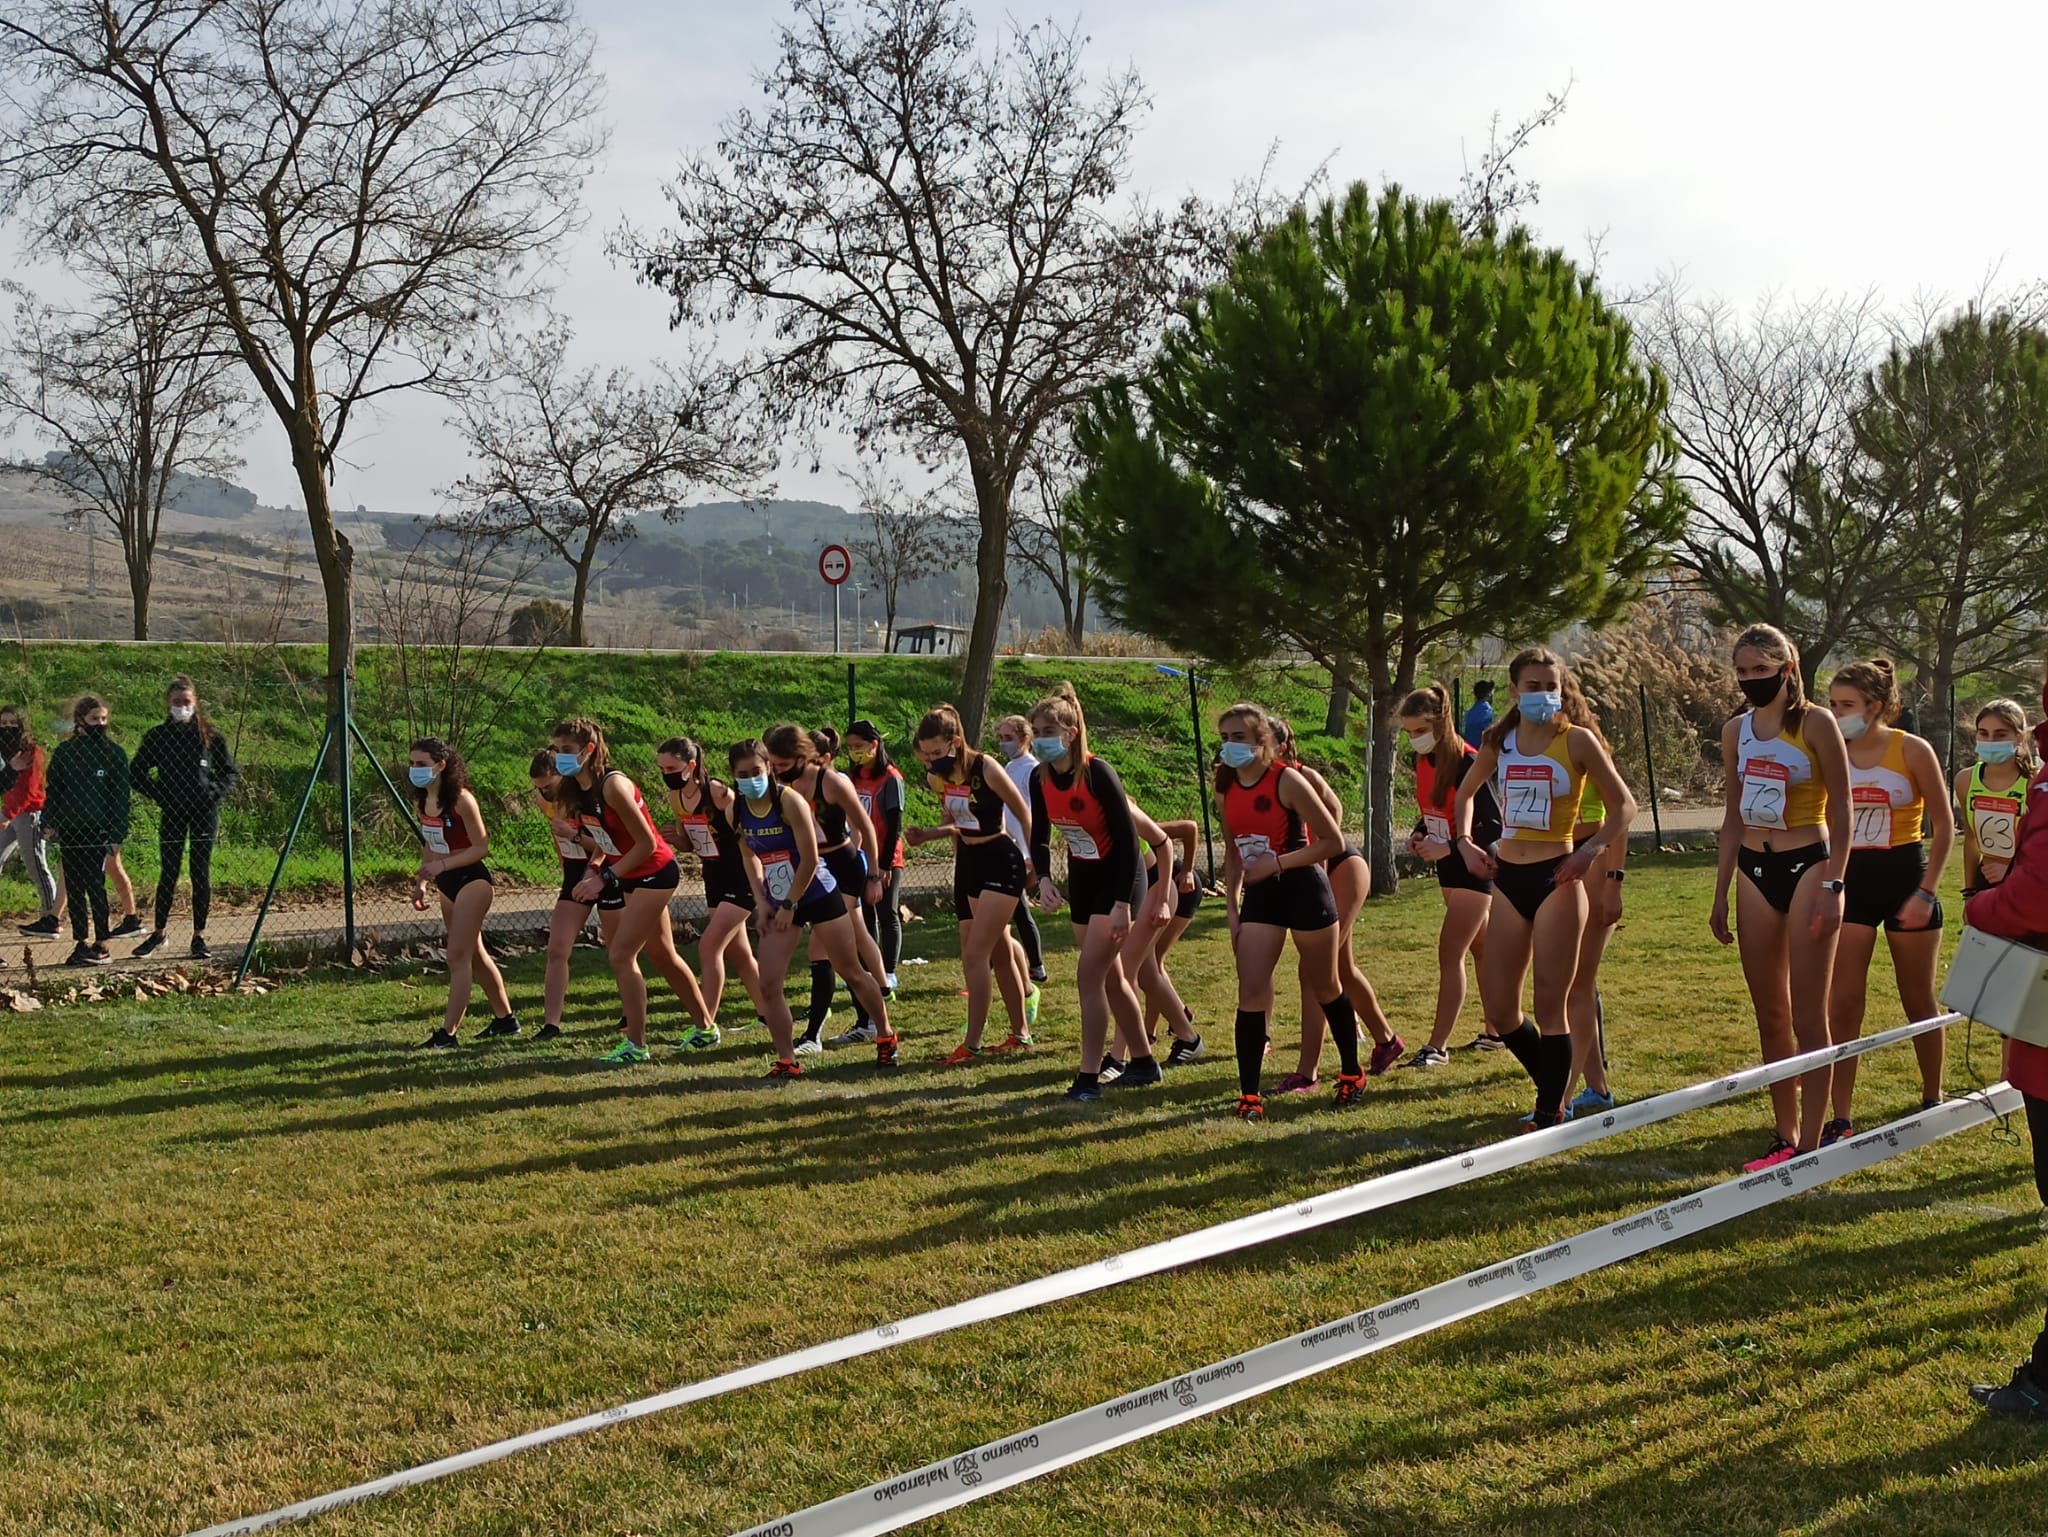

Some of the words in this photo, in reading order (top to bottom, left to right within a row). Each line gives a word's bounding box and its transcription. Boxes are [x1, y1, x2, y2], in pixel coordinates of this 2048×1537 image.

[1508, 786, 1548, 827] 74
[1744, 781, 1781, 823] 73
[1853, 806, 1886, 842] 70
[1979, 815, 2014, 850] 63
[688, 828, 713, 854] 57
[768, 862, 793, 896] 69
[1789, 1156, 1819, 1172] Gobierno
[1670, 1197, 1703, 1215] Gobierno
[1612, 1215, 1655, 1237] Nafarroako
[1534, 1244, 1571, 1264] Gobierno
[1467, 1265, 1515, 1288] Nafarroako
[1377, 1298, 1420, 1320] Gobierno
[1300, 1321, 1356, 1348] Nafarroako
[1196, 1360, 1246, 1385] Gobierno
[1105, 1388, 1169, 1418] Nafarroako
[982, 1434, 1039, 1462] Gobierno
[873, 1465, 950, 1502] Nafarroako
